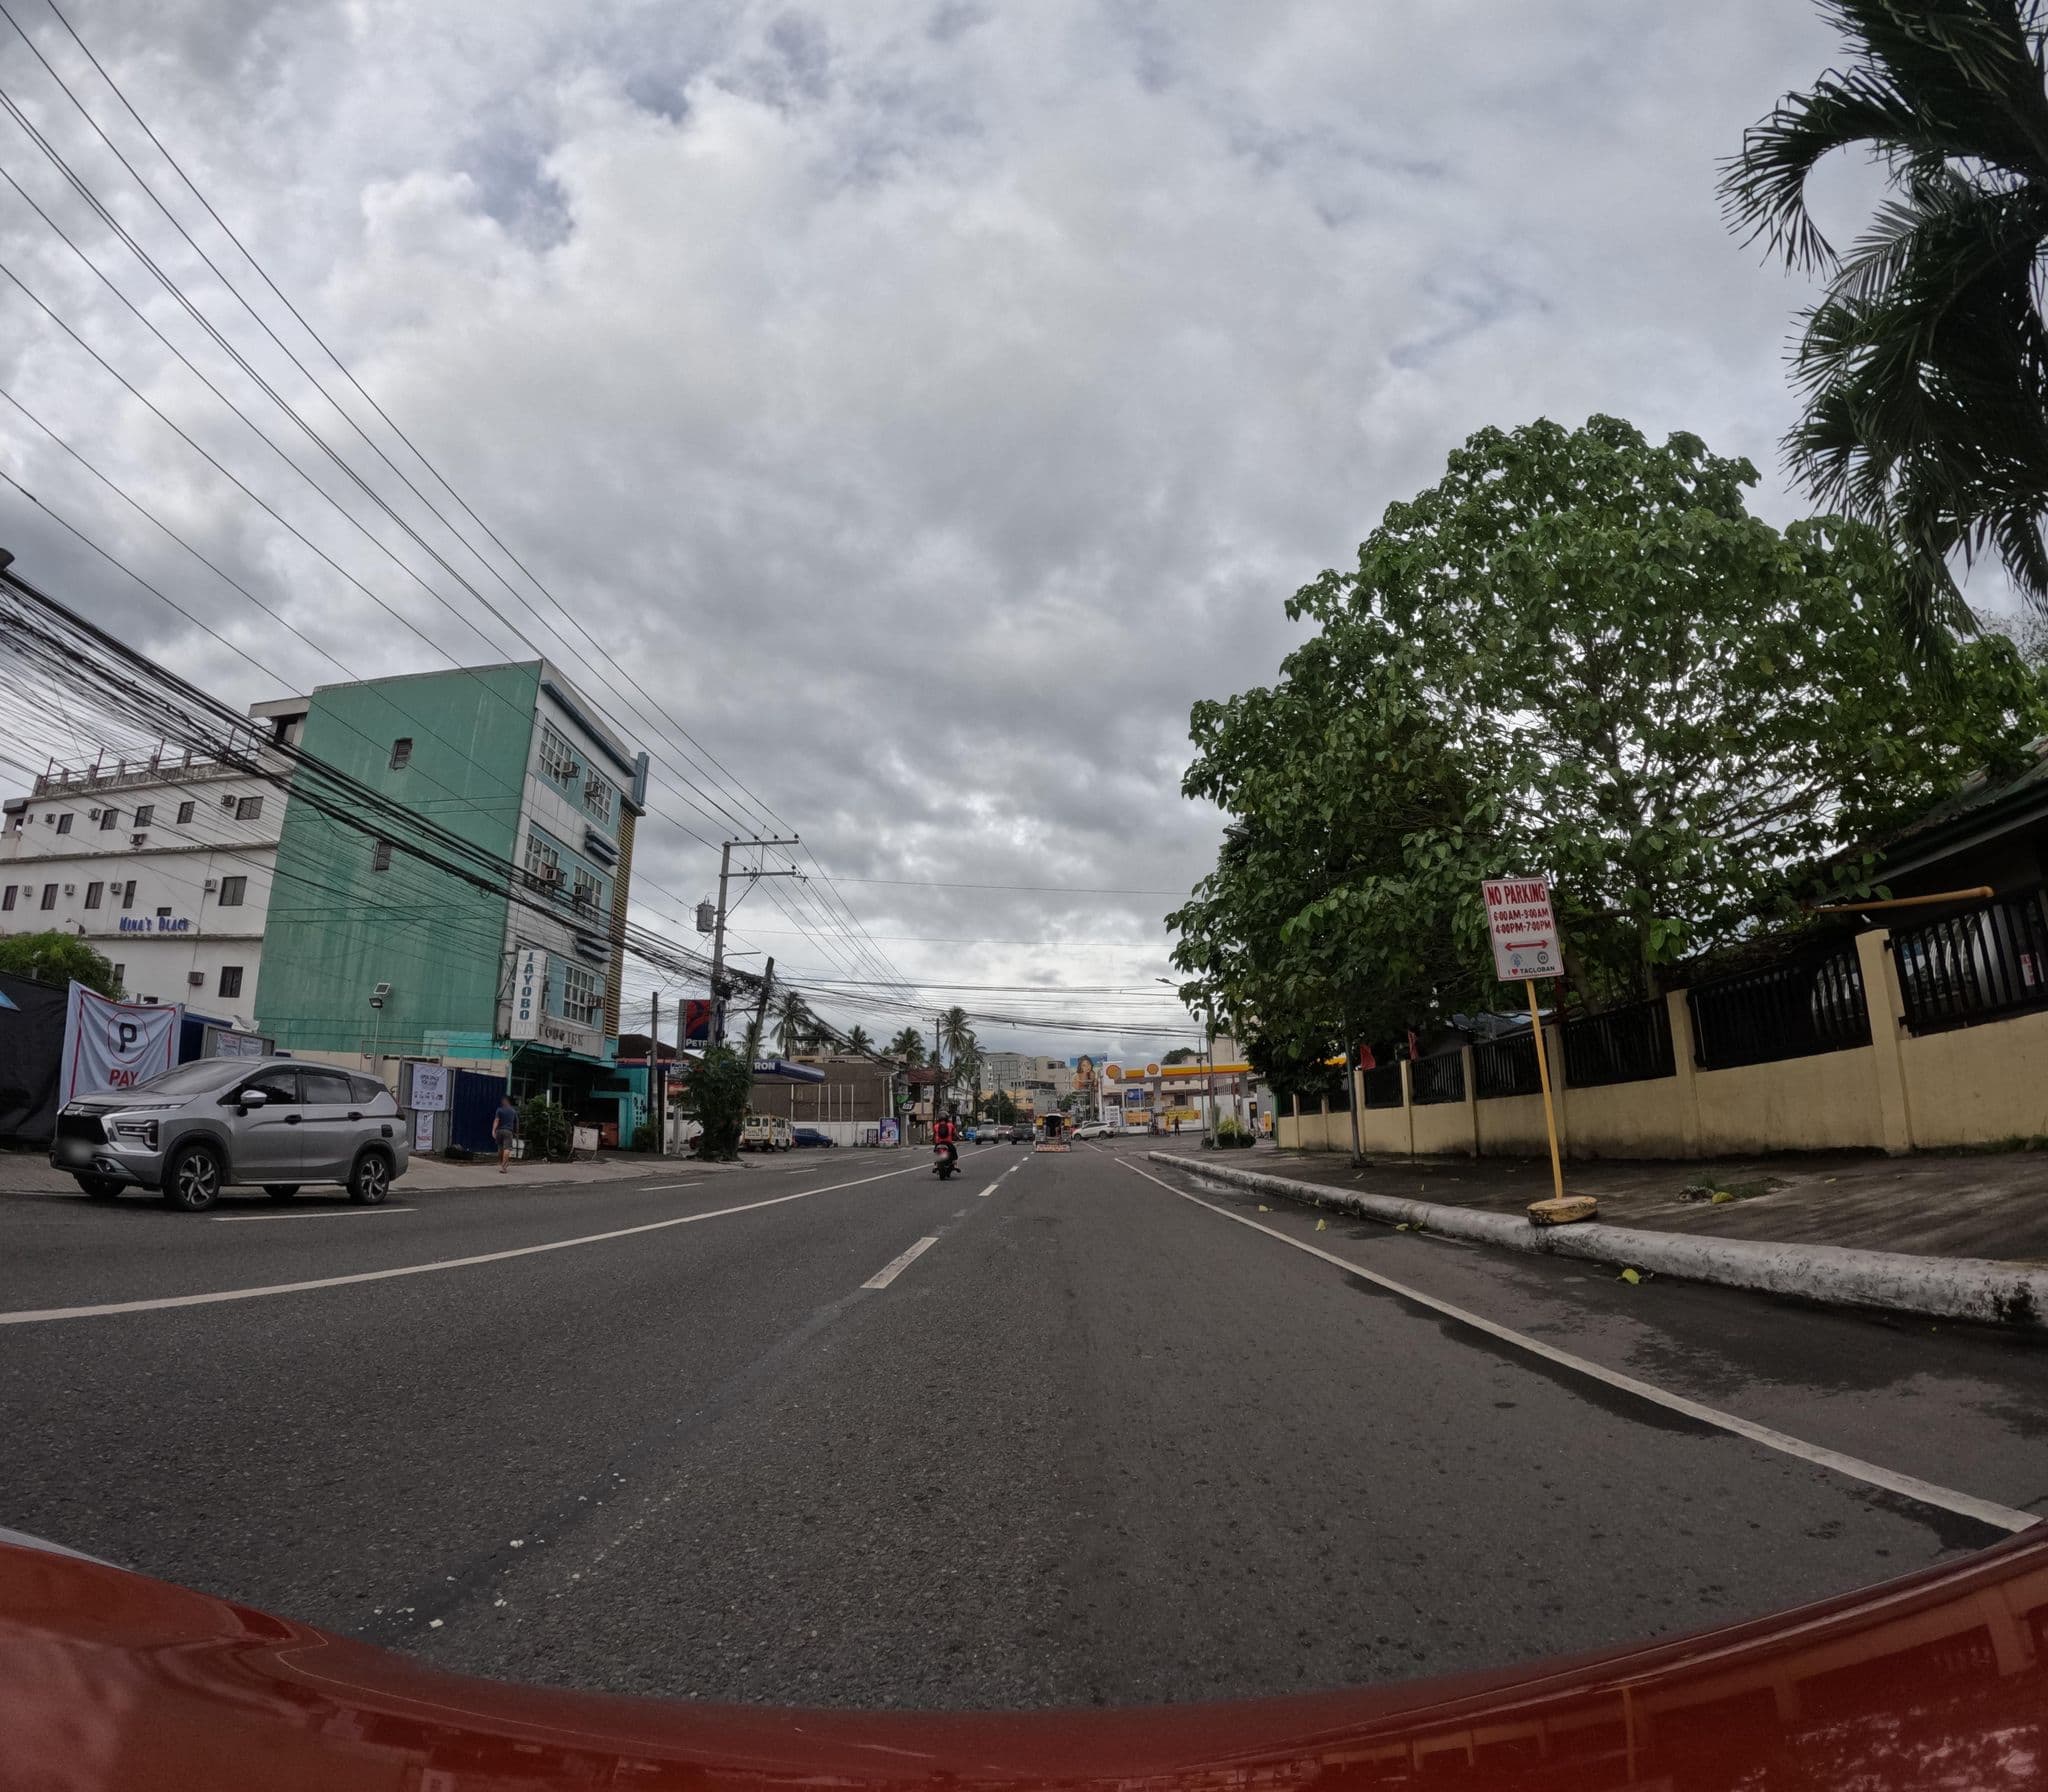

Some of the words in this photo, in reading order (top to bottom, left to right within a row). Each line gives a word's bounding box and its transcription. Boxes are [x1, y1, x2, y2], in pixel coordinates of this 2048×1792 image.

[1487, 885, 1502, 906] NO
[1504, 883, 1546, 904] PARKING
[1520, 966, 1555, 974] TACLOBAN
[119, 1023, 137, 1053] P
[109, 1069, 139, 1087] PAY
